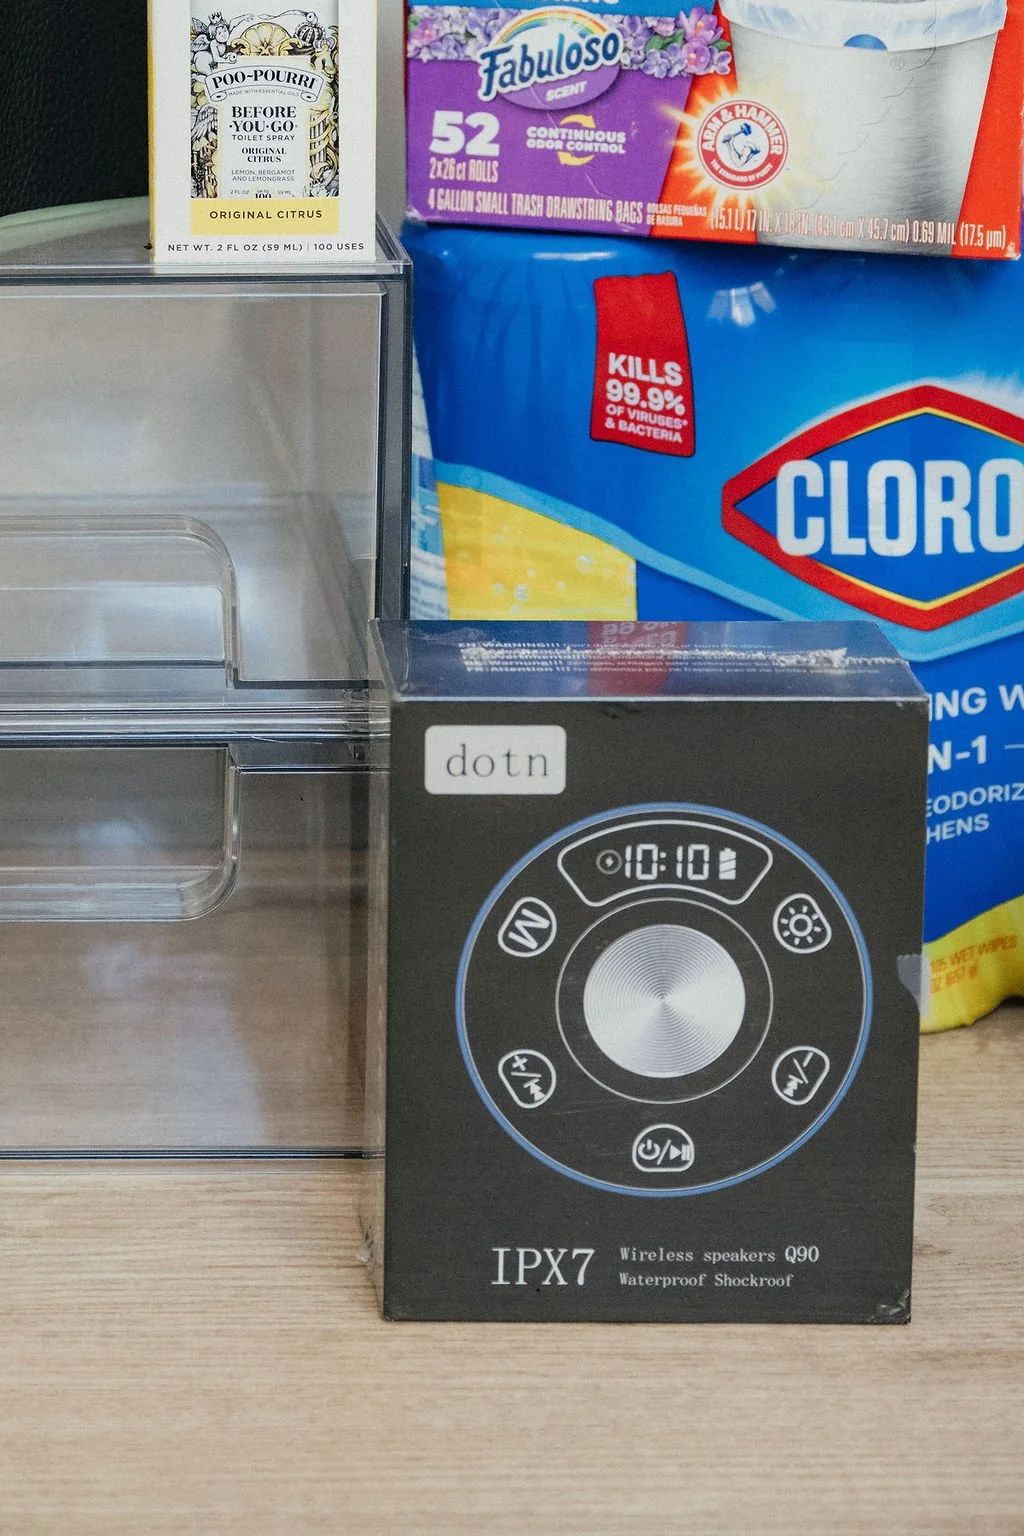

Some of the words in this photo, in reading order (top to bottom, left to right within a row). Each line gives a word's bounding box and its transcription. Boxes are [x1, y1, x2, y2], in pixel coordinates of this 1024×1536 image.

[480, 32, 620, 97] Fabuloso
[545, 81, 588, 101] SCENT
[232, 106, 297, 118] BEFORE
[429, 110, 500, 157] 52
[526, 126, 626, 143] CONTINUOUS
[702, 116, 723, 152] ARM
[720, 109, 734, 122] &
[734, 105, 783, 155] HAMMER
[241, 147, 287, 155] ORIGINAL
[247, 155, 282, 163] CITRUS
[526, 139, 564, 151] ODOR
[566, 141, 626, 154] CONTROL
[468, 159, 499, 183] ROLLS
[209, 210, 272, 219] ORIGINAL
[277, 210, 322, 219] CITRUS
[428, 188, 435, 209] 4
[437, 188, 474, 212] GALLON
[475, 190, 508, 215] SMALL
[511, 193, 544, 217] TRASH
[546, 195, 614, 222] DRAWSTRING
[615, 199, 643, 224] BAGS
[646, 214, 655, 225] DE
[711, 207, 732, 230] (15.1
[734, 207, 744, 232] L)
[746, 209, 757, 231] 17
[839, 219, 854, 238] cm
[867, 218, 888, 240] 45.7
[891, 218, 910, 243] cm)
[912, 220, 935, 244] 0.69
[937, 221, 957, 246] MIL
[960, 221, 984, 247] (17.5
[168, 244, 188, 252] NET
[193, 244, 213, 252] WT.
[217, 244, 223, 252] 2
[262, 243, 280, 252] (59
[283, 243, 303, 252] ML)
[314, 243, 333, 251] 100
[337, 243, 364, 251] USES
[608, 352, 683, 387] KILLS
[606, 378, 685, 416] 99.9%
[606, 404, 624, 416] OF
[605, 417, 615, 429] &
[618, 419, 683, 443] BACTERIA
[776, 458, 1024, 557] CLORO
[446, 743, 549, 778] dotn
[625, 843, 710, 881] 10:10
[491, 1247, 595, 1286] IPX7
[619, 1246, 694, 1263] Wireless
[703, 1247, 776, 1264] speakers
[784, 1246, 820, 1264] Q90
[619, 1272, 707, 1288] Waterproof
[714, 1272, 795, 1288] Shockroof
